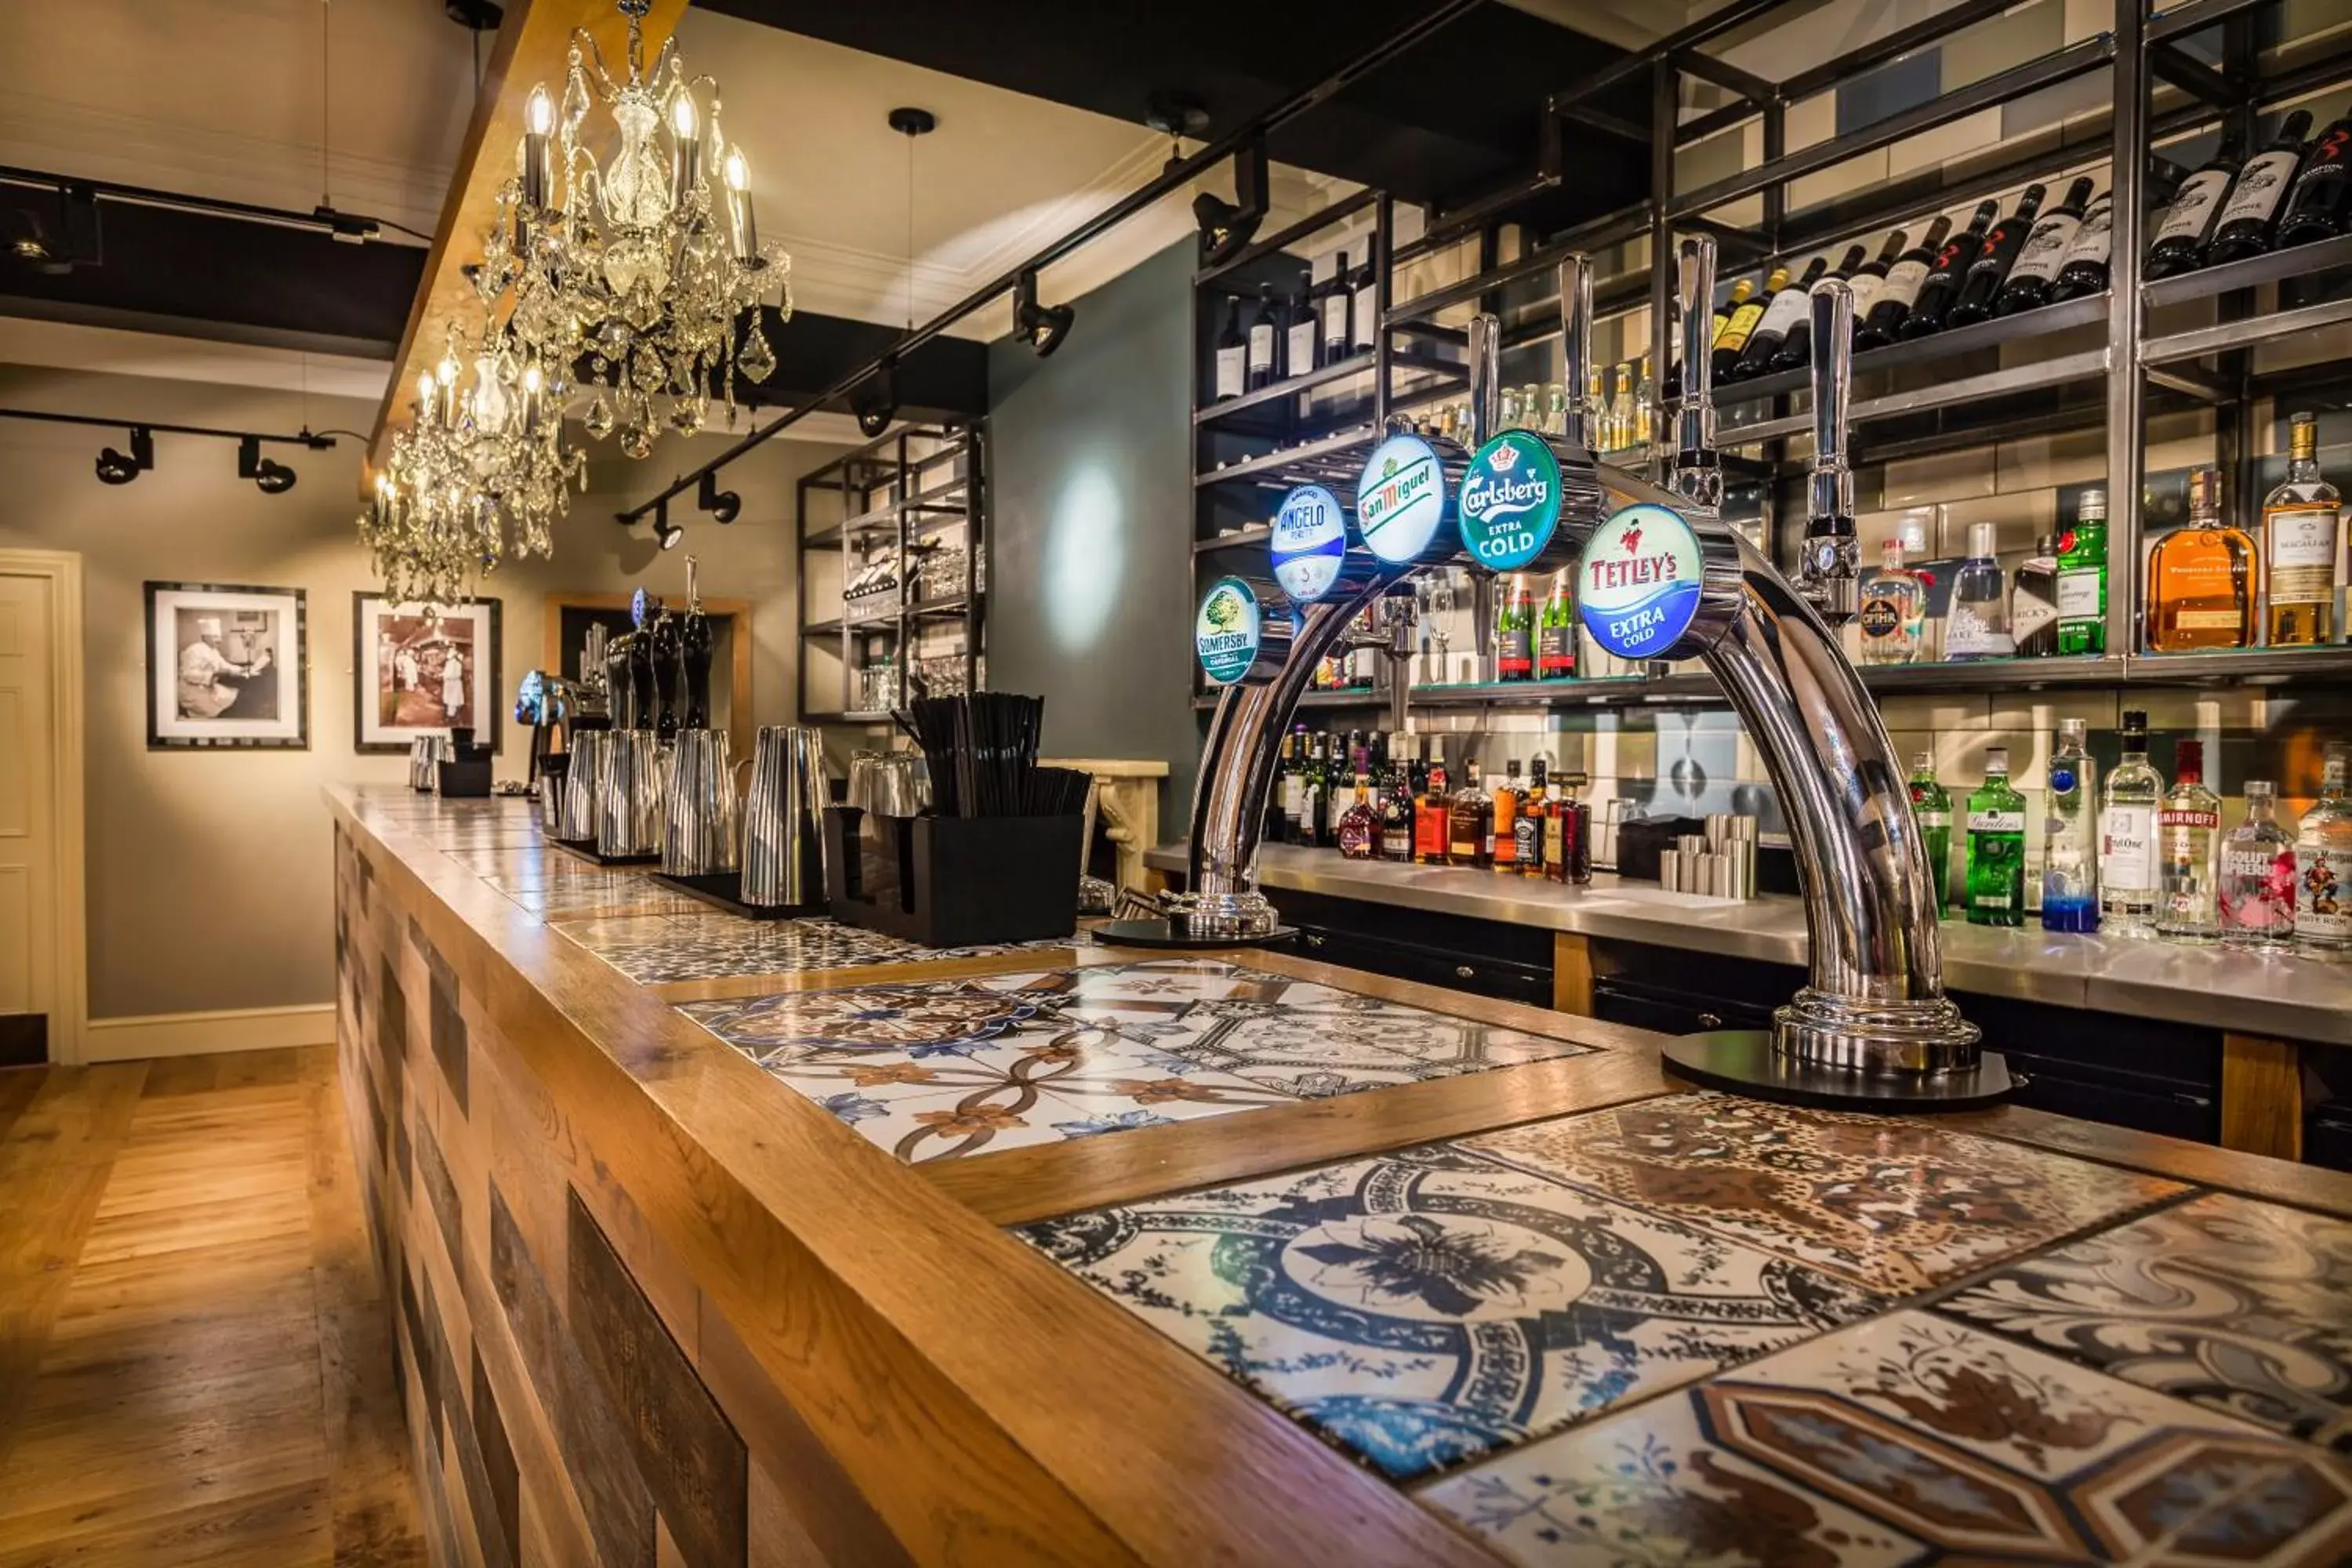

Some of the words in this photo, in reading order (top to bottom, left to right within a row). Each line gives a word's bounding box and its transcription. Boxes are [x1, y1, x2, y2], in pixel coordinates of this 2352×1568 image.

[1360, 498, 1384, 527] San
[1377, 466, 1430, 510] Miguel
[1461, 477, 1548, 517] Carlsberg
[1280, 505, 1325, 532] ANGELO
[1490, 521, 1522, 535] EXTRA
[1479, 532, 1534, 557] COLD
[1589, 551, 1679, 590] TETLEY'S
[1610, 605, 1665, 638] EXTRA
[1199, 633, 1248, 654] SOMERSBY
[1623, 627, 1654, 648] COLD
[2158, 812, 2215, 826] SMIRNOFF
